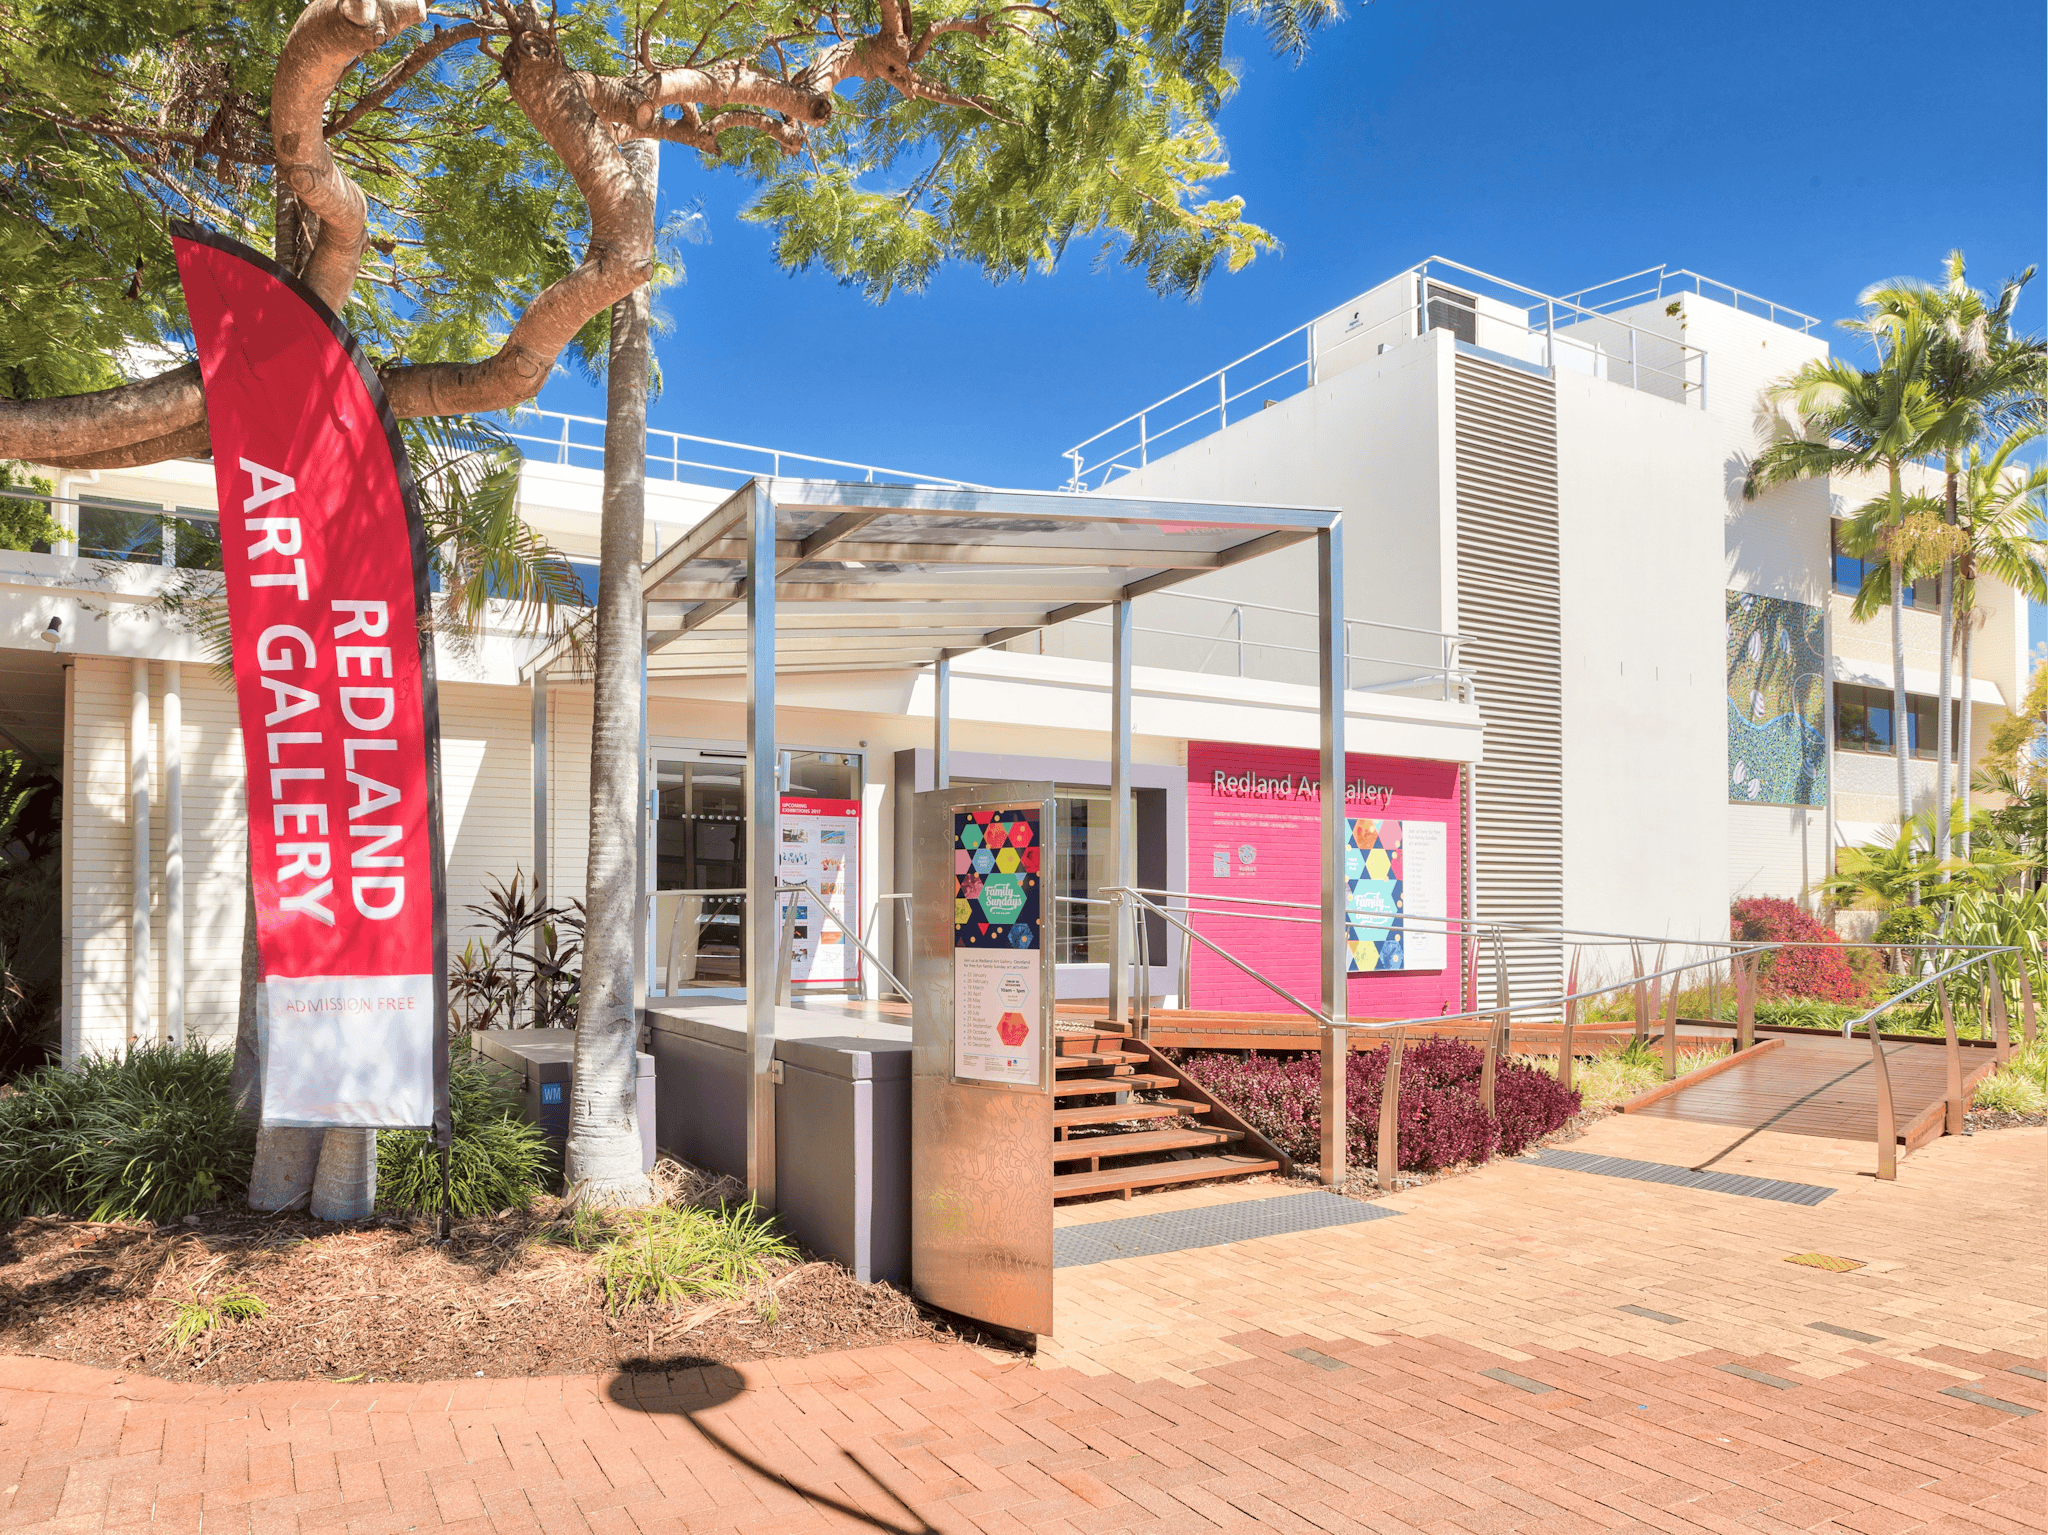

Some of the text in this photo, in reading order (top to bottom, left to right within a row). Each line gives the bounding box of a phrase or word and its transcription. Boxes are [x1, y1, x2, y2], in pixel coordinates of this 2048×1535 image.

[239, 456, 336, 927] ART GALLERY
[331, 599, 405, 921] REDLAND
[1214, 770, 1394, 806] Redland Ar allery
[985, 883, 1020, 899] Family
[986, 896, 1022, 909] Sundays
[1354, 892, 1390, 911] Family
[286, 997, 415, 1013] ADMISSION FREE
[544, 1087, 561, 1100] WM
